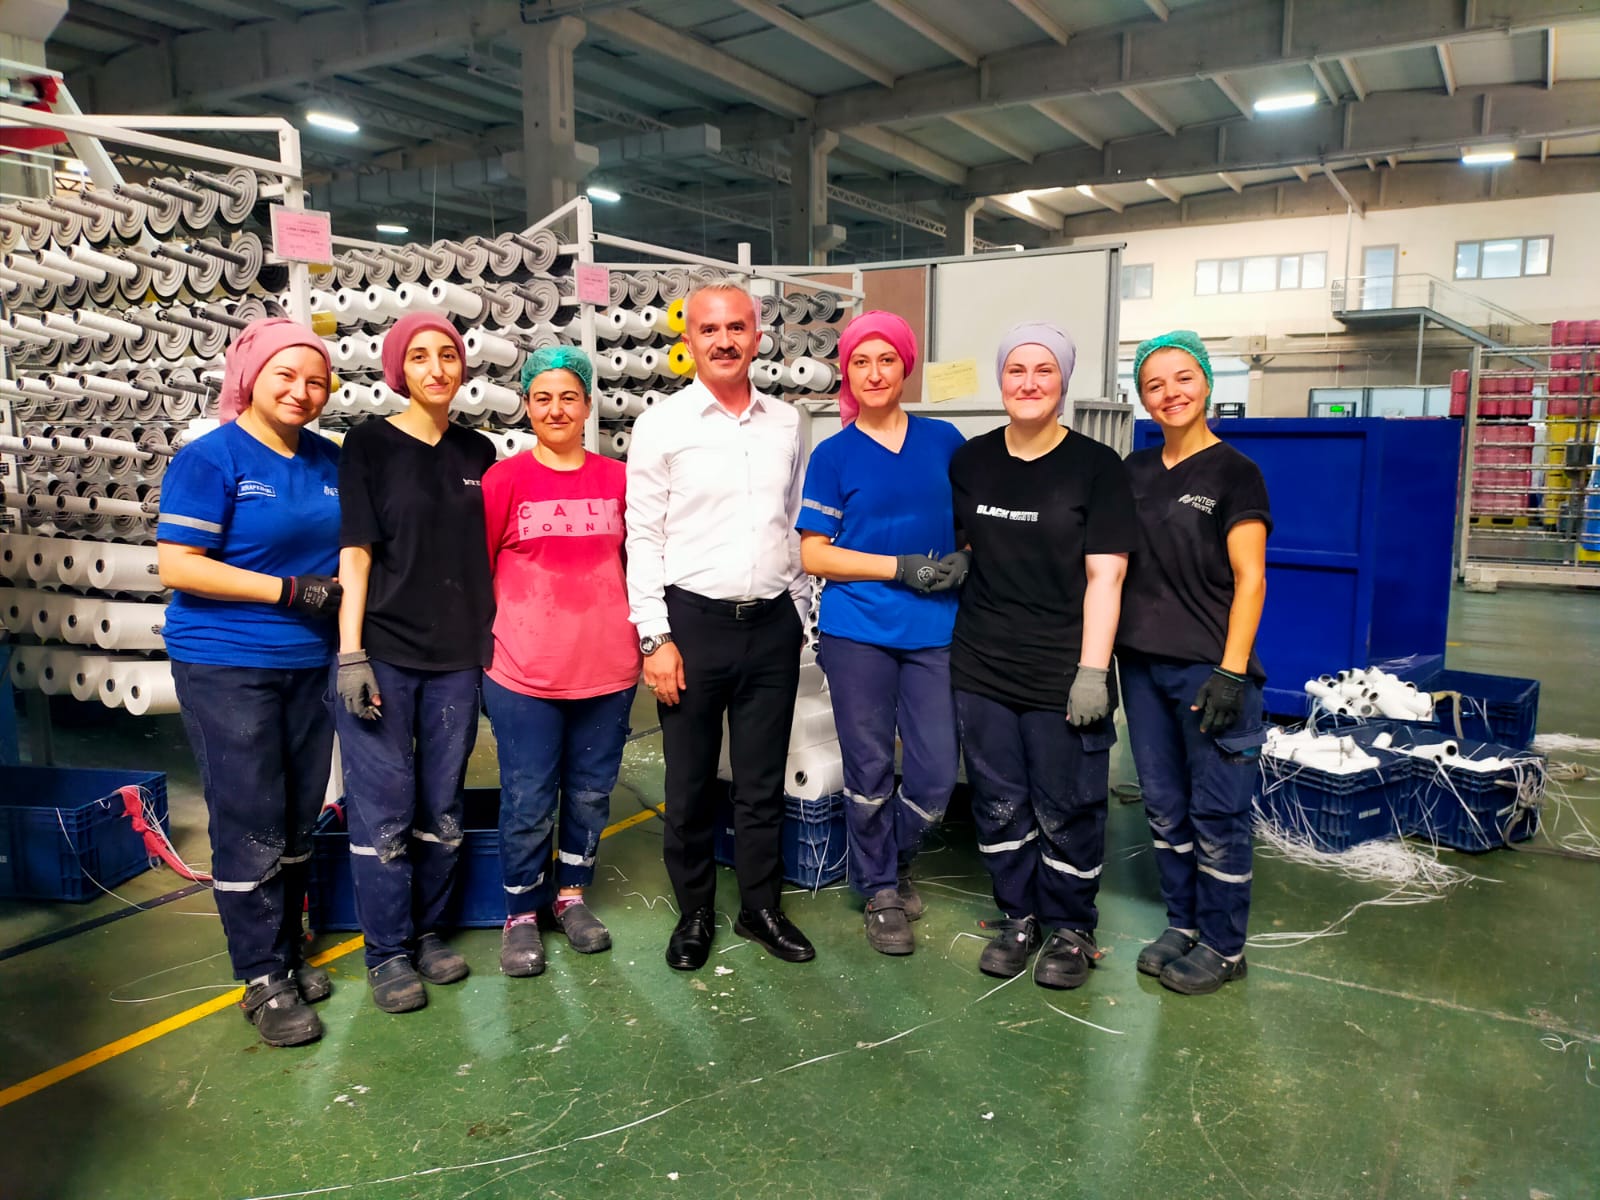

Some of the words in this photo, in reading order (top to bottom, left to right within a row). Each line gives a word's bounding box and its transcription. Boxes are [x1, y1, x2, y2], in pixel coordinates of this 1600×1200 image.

[519, 502, 617, 519] CAL
[976, 504, 1010, 519] BLACK
[1009, 511, 1040, 522] WHITE
